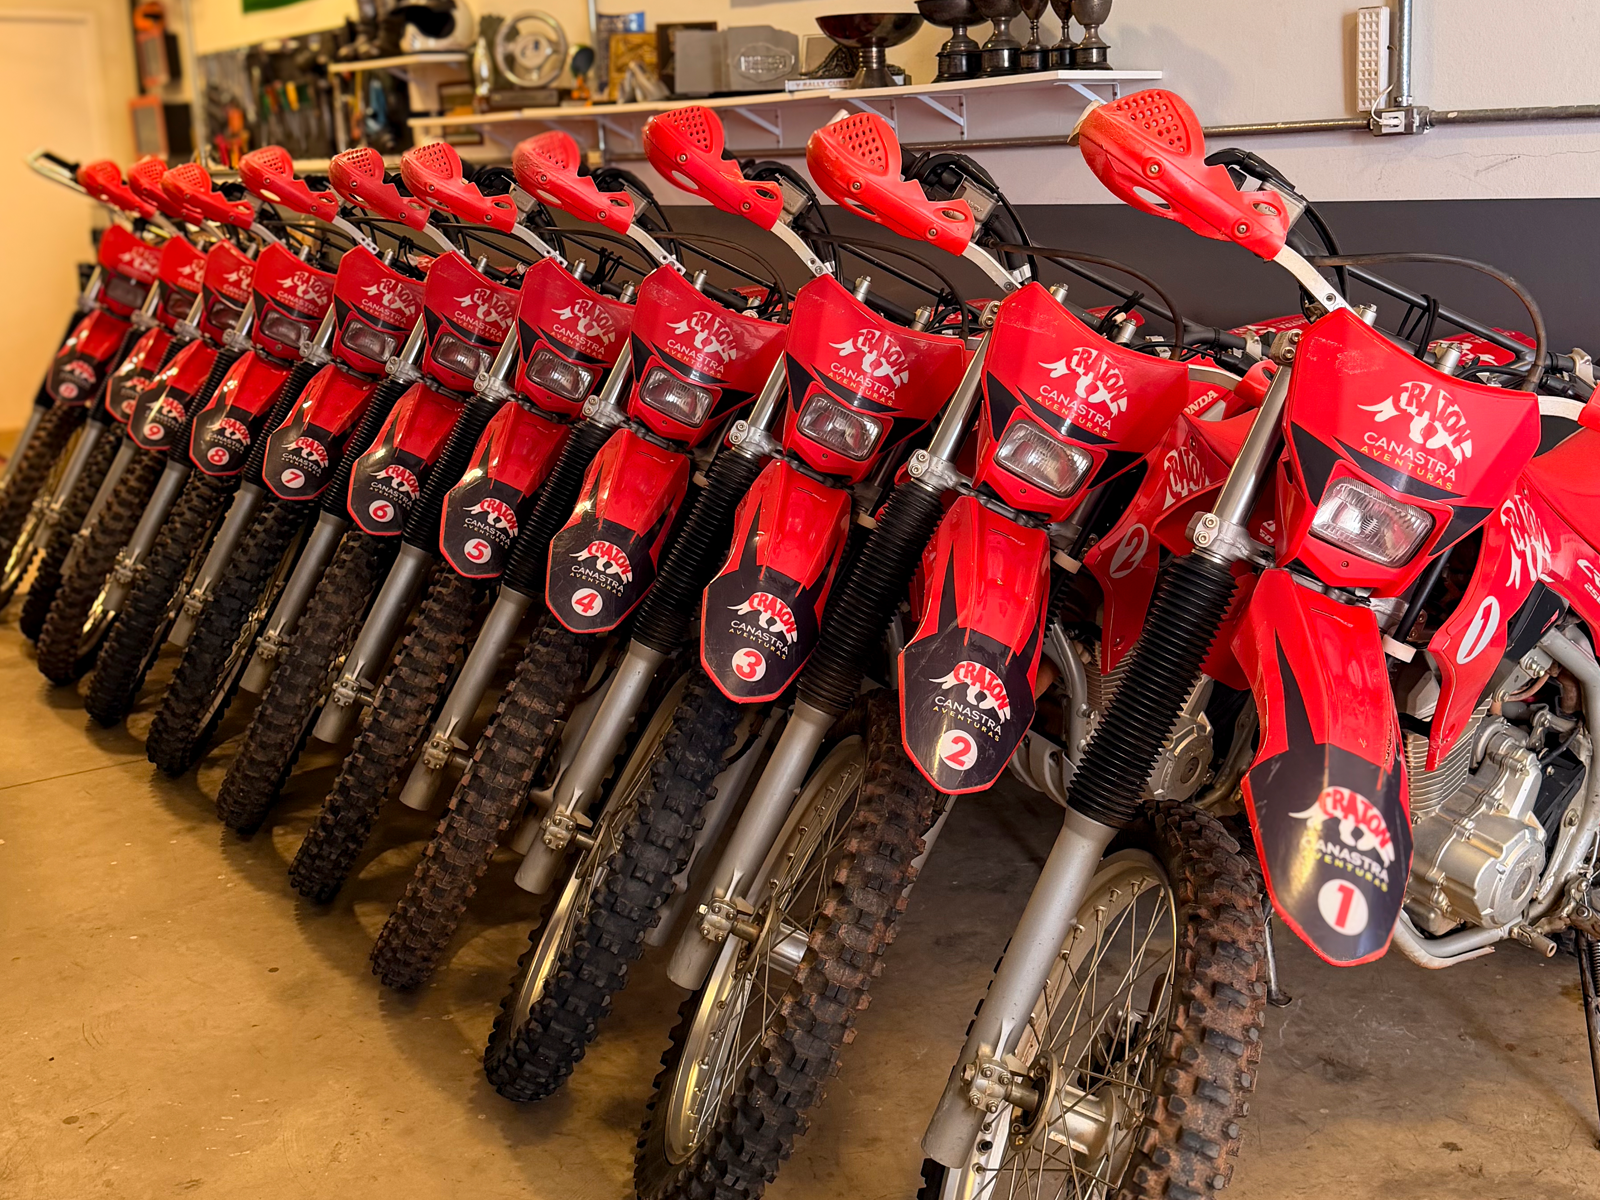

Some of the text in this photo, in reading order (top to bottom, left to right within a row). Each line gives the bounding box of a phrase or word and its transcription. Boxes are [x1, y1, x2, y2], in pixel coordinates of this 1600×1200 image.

[361, 298, 406, 324] CANASTRA
[454, 310, 503, 337] CANASTRA
[552, 323, 605, 354] CANASTRA
[664, 346, 722, 378] AVENTURAS
[667, 339, 724, 373] CANASTRA
[827, 371, 893, 406] AVENTURAS
[830, 362, 896, 400] CANASTRA
[1035, 395, 1109, 438] AVENTURAS
[1039, 384, 1112, 431] CANASTRA
[1184, 389, 1219, 416] ONDA
[148, 425, 161, 437] 9
[210, 448, 227, 463] 8
[282, 452, 321, 474] CANASTRA
[1359, 445, 1453, 491] AVENTURAS
[1363, 431, 1456, 482] CANASTRA
[284, 471, 302, 484] 7
[371, 481, 412, 507] CANASTRA
[385, 465, 419, 493] CRATON
[372, 503, 391, 520] 6
[480, 498, 518, 530] CRATON
[464, 517, 510, 546] CANASTRA
[466, 541, 489, 561] 5
[587, 541, 631, 575] CRATON
[1111, 526, 1145, 575] 2
[571, 565, 624, 593] CANASTRA
[574, 592, 599, 614] 4
[748, 592, 796, 634] CRATON
[728, 628, 786, 660] AVENTURAS
[731, 620, 788, 655] CANASTRA
[1463, 601, 1493, 660] 1
[735, 650, 763, 679] 3
[953, 661, 1009, 711] CRATON
[932, 706, 1000, 742] AVENTURAS
[935, 696, 1001, 736] CANASTRA
[944, 735, 972, 768] 2
[1318, 789, 1391, 849] CRATON
[1301, 836, 1389, 883] CANASTRA
[1304, 851, 1388, 893] VENTURAS
[1337, 883, 1355, 929] 1
